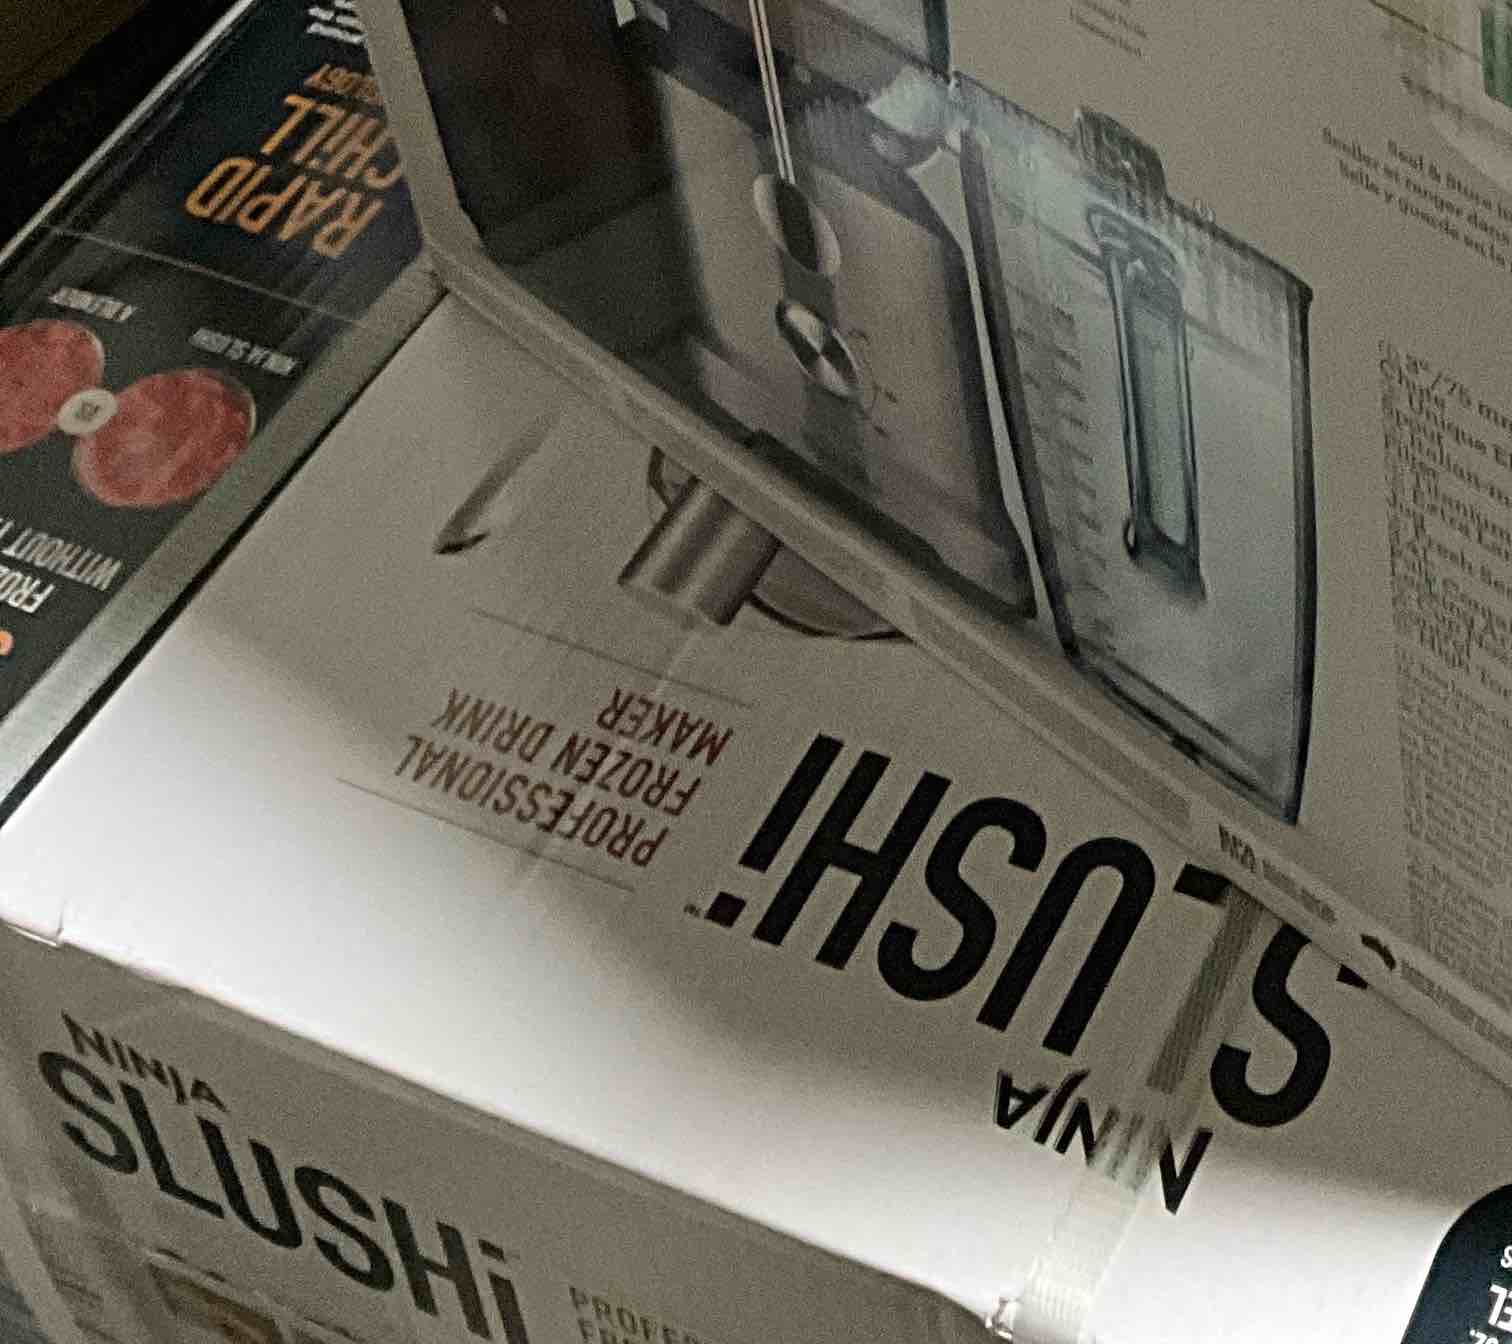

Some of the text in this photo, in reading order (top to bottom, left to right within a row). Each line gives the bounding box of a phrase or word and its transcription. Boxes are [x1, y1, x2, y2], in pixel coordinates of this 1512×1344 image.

[186, 157, 385, 258] RAPID
[2, 526, 123, 592] WITHOUT
[431, 687, 701, 816] FROZEN DRINK
[595, 686, 734, 767] MAKER
[394, 735, 669, 868] PROFESSIONAL
[62, 1011, 230, 1113] NINJA
